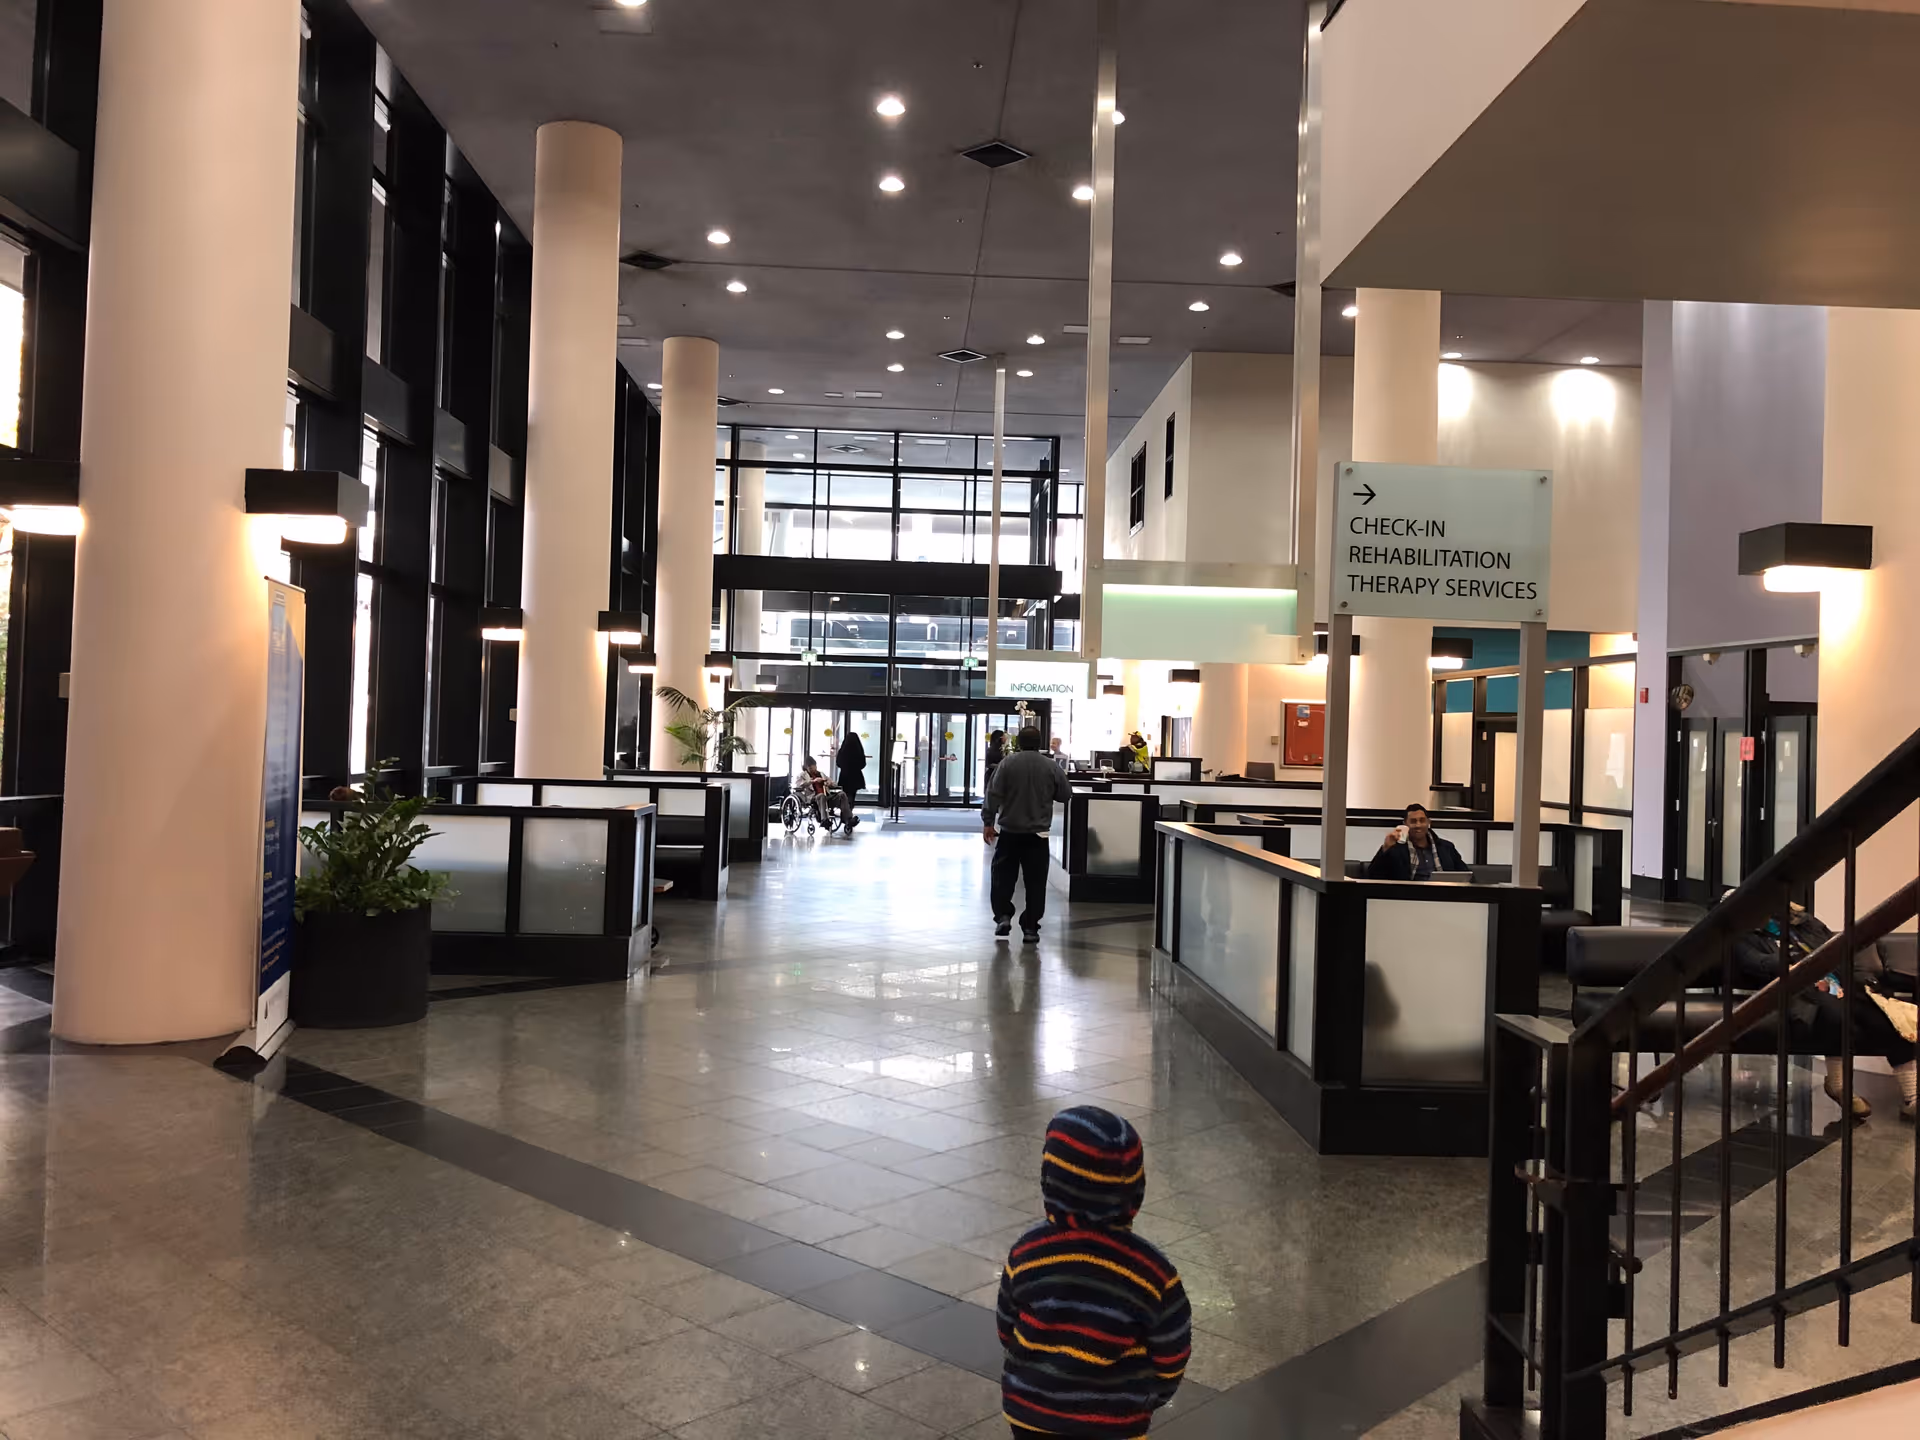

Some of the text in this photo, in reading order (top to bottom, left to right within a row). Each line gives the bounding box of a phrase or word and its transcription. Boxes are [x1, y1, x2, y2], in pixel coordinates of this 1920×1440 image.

[1349, 516, 1445, 538] CHECK-IN
[1349, 545, 1512, 570] REHABILITATION
[1347, 574, 1538, 600] THERAPY SERVICES
[1010, 682, 1074, 693] INFORMATION
